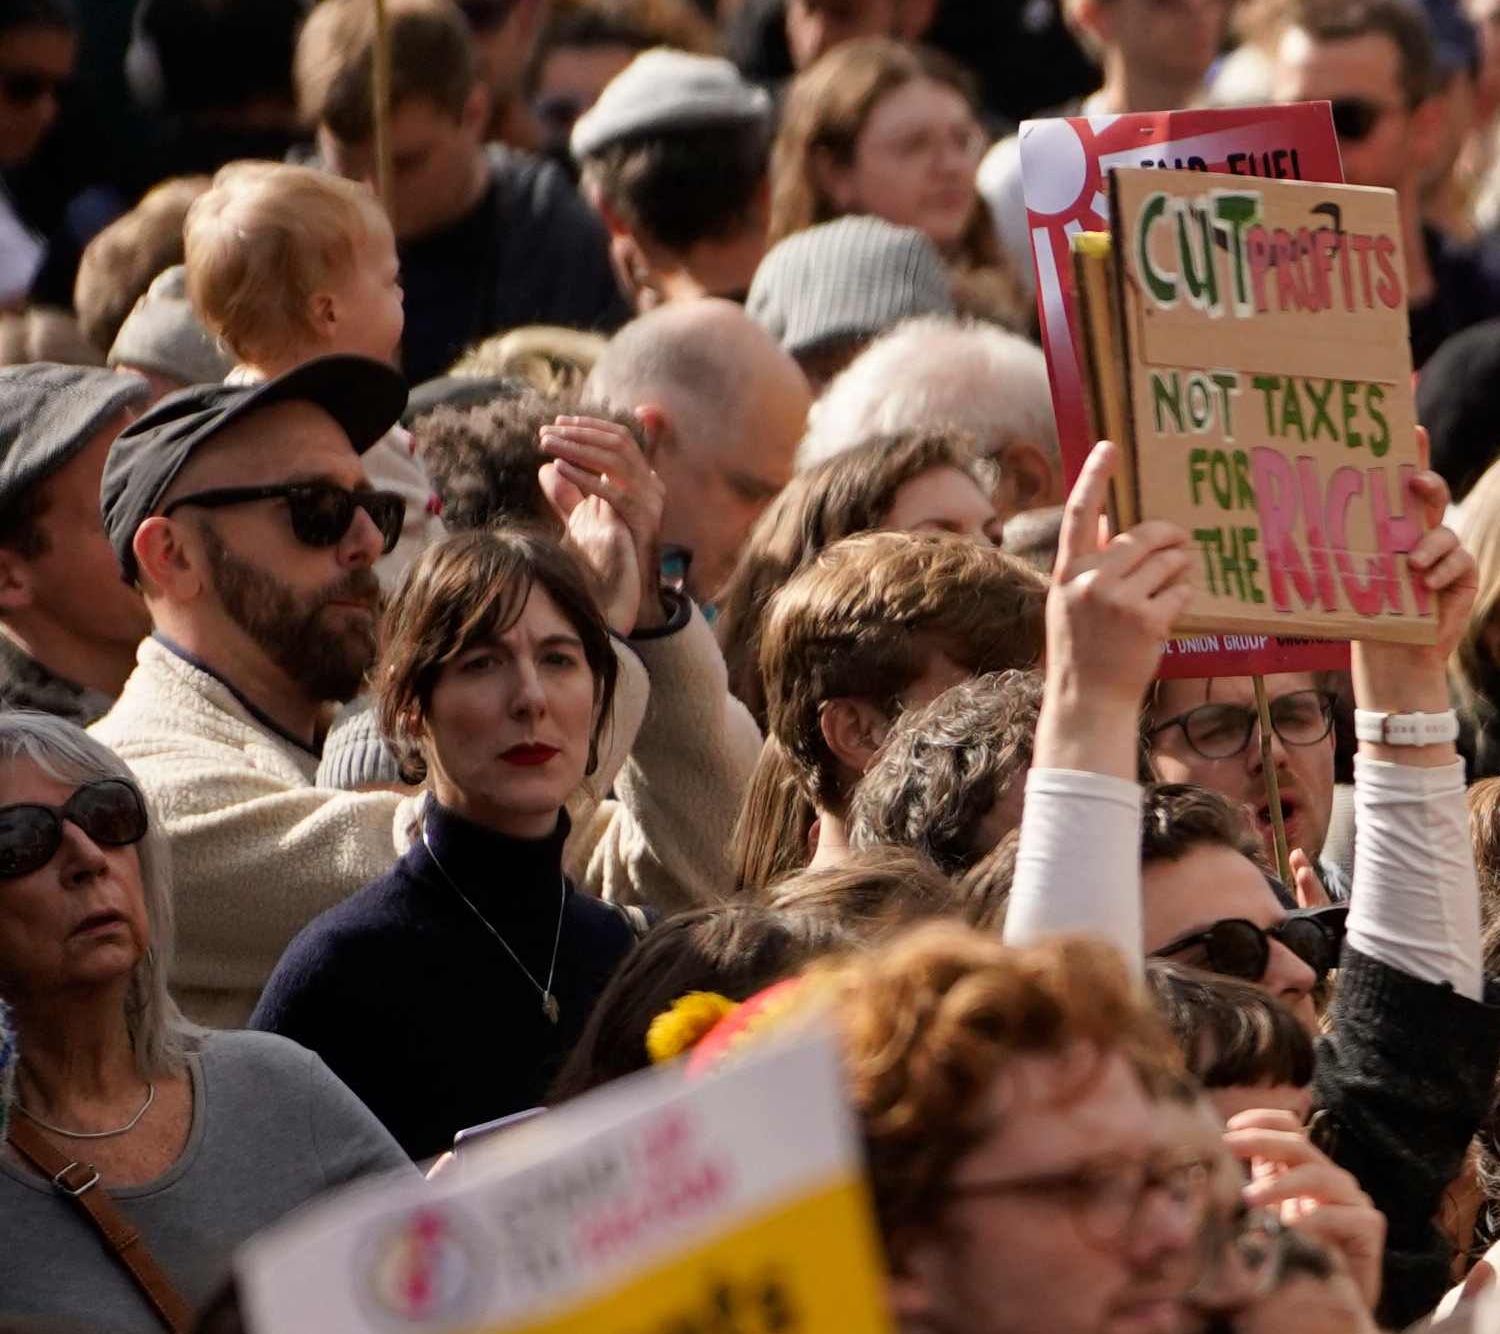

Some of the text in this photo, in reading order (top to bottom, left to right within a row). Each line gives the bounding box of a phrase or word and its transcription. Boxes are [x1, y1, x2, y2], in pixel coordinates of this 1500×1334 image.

[1137, 188, 1402, 319] CUT PROFITS
[1150, 371, 1392, 458] NOT TAXES
[1188, 447, 1257, 511] FOR
[1193, 445, 1434, 616] THE RICH
[1176, 634, 1219, 654] UNION
[1223, 634, 1268, 651] GROUP
